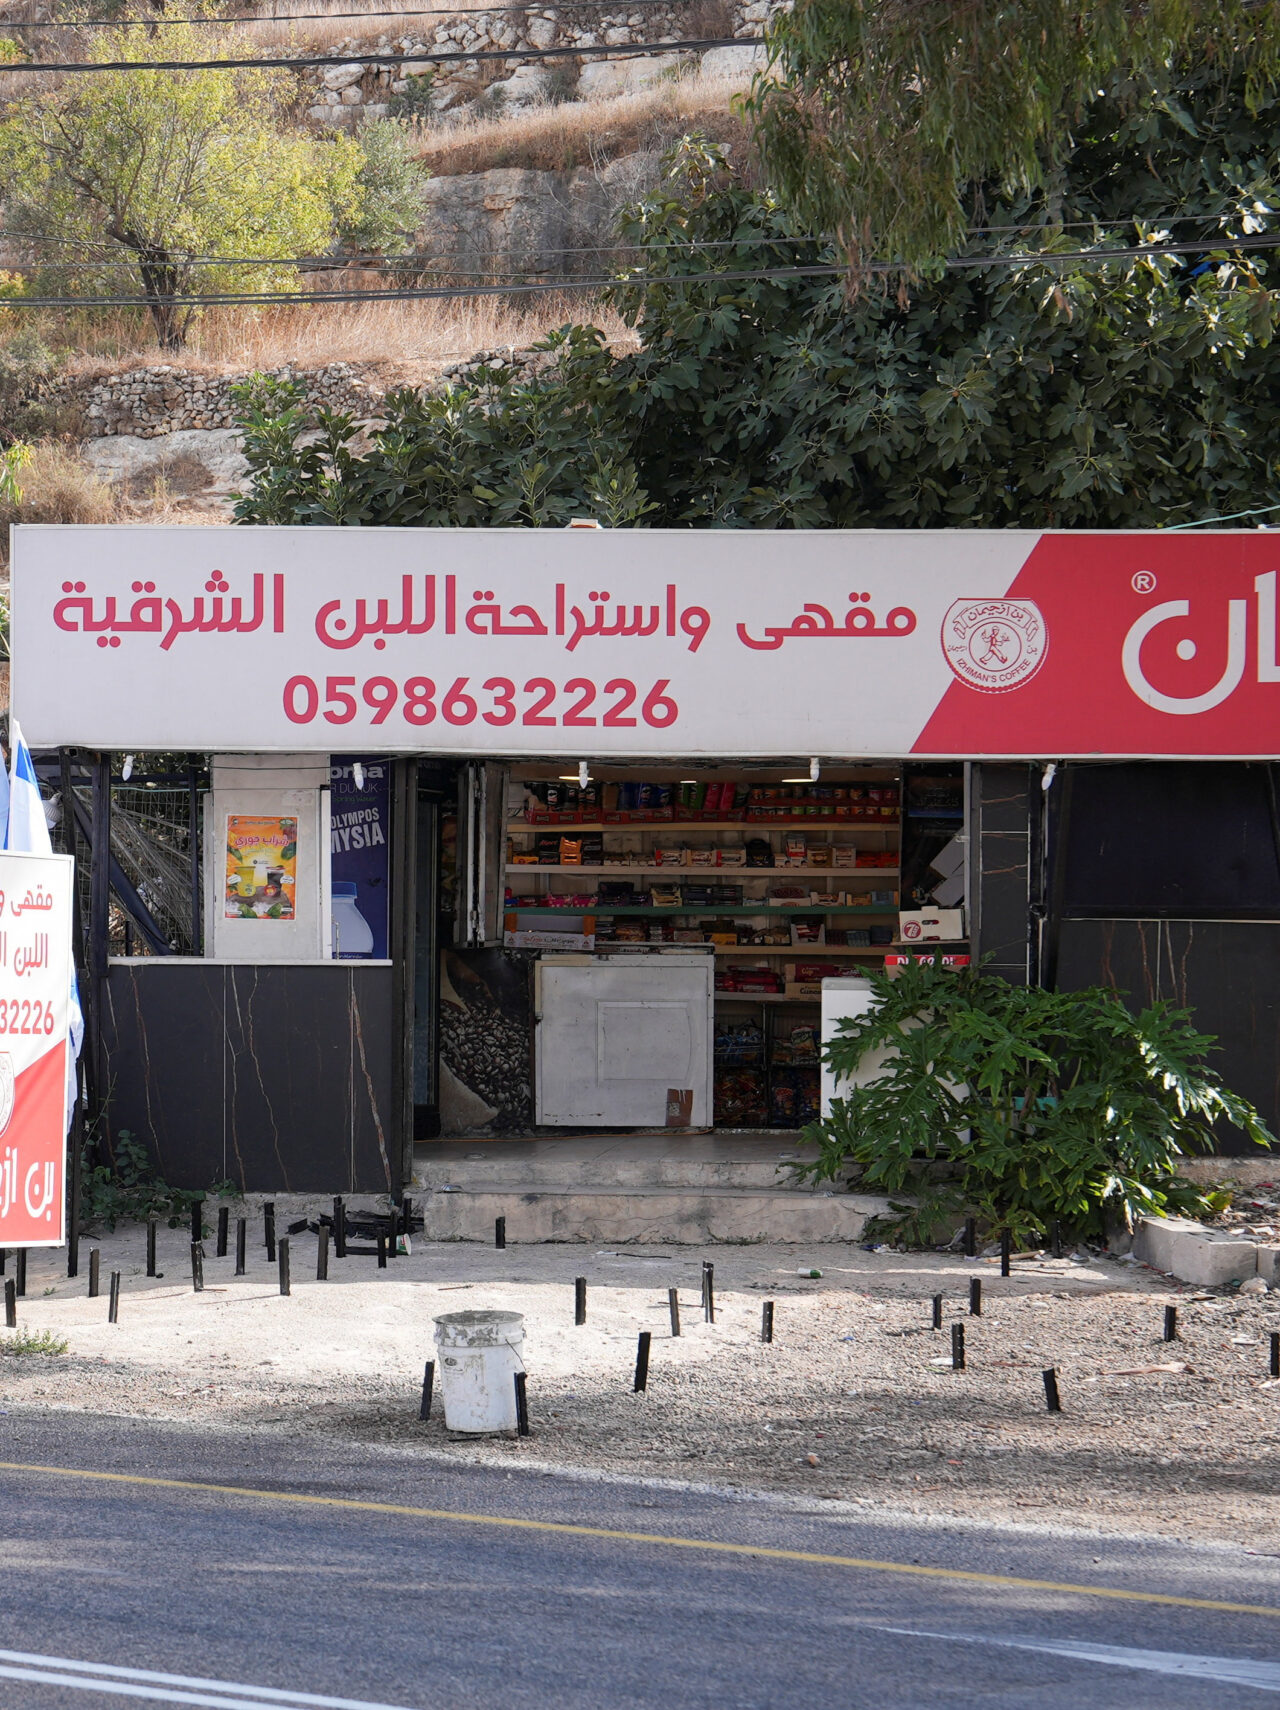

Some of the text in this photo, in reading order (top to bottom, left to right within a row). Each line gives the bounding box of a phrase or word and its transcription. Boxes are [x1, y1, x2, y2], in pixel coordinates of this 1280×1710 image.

[53, 569, 917, 653] مقهى واستراحة اللبن الشرقية
[956, 657, 1031, 683] IZHIMAN'S COFFEE
[283, 675, 678, 728] 0598632226
[11, 884, 53, 917] مقهى
[14, 932, 49, 977] اللبن
[24, 1161, 55, 1222] بن
